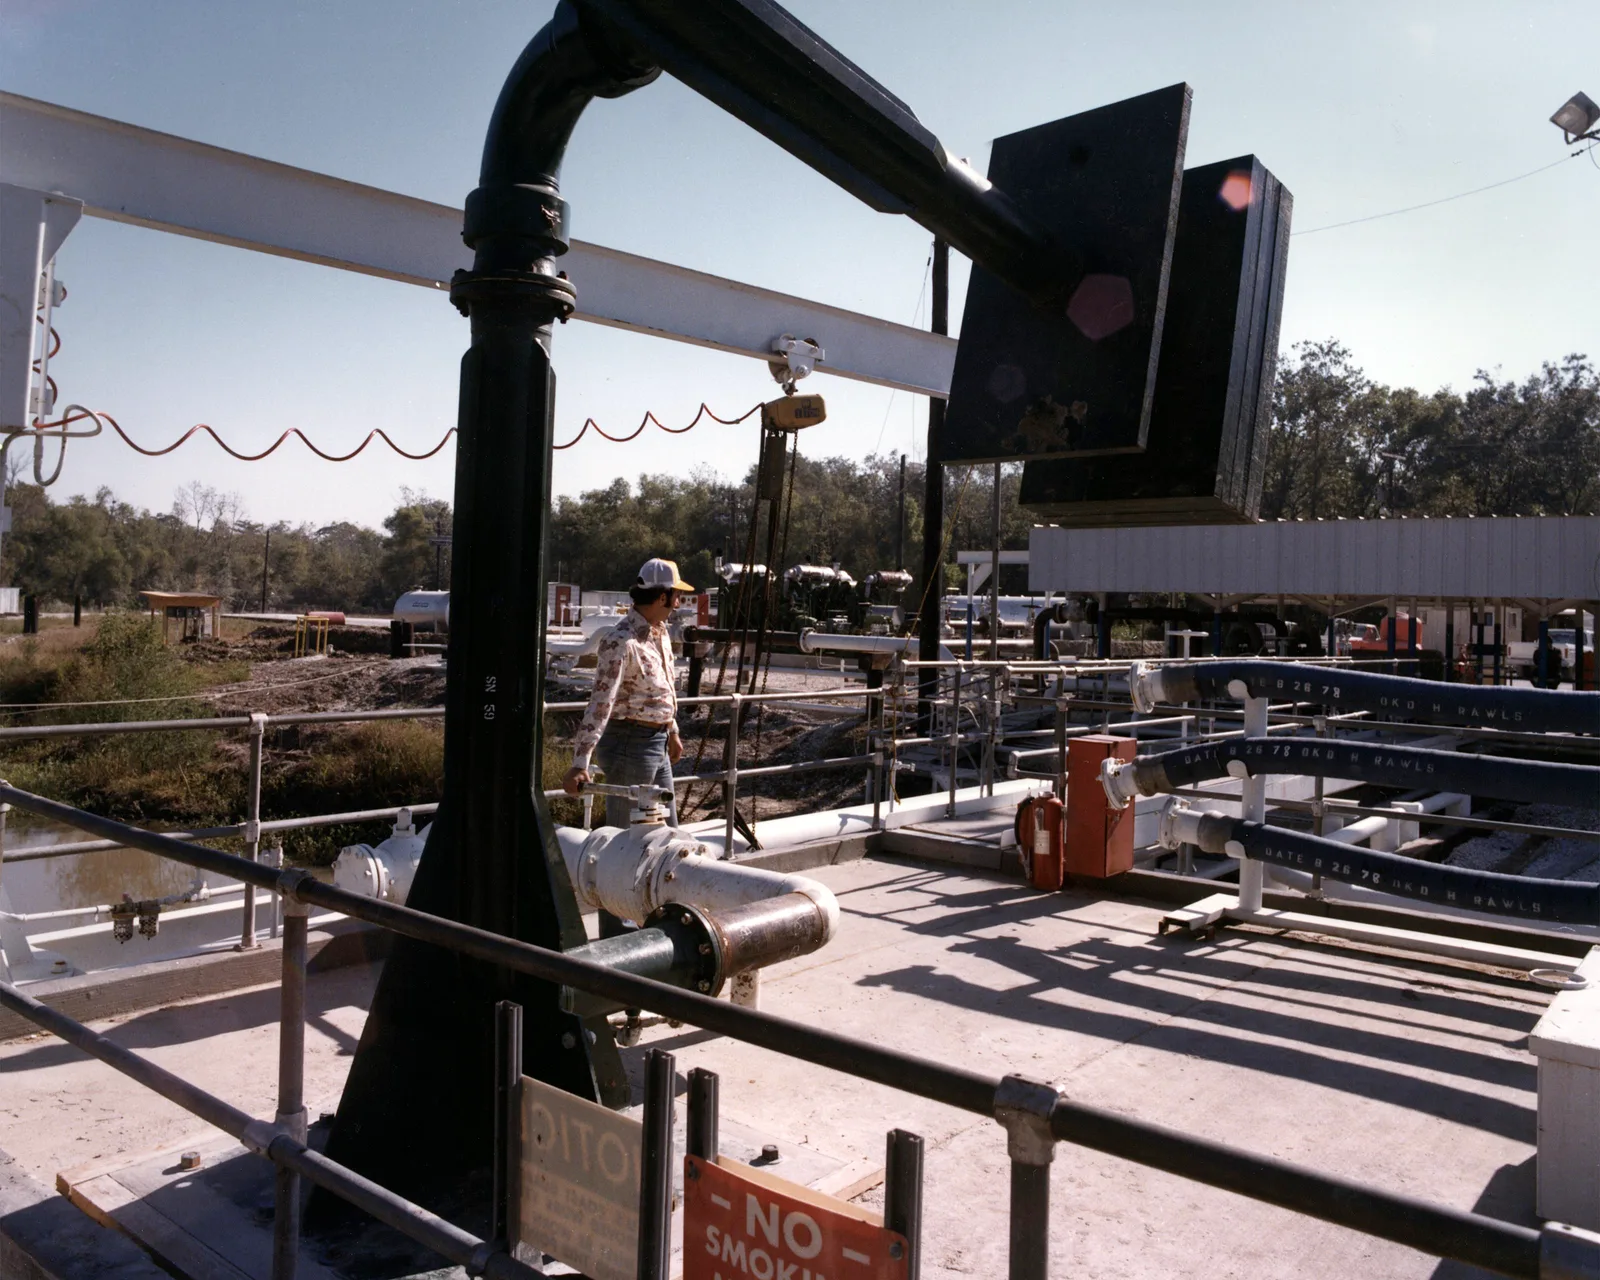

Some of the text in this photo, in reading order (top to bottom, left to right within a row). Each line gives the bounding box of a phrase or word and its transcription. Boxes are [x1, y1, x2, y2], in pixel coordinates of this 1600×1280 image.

[485, 676, 497, 692] SN
[1321, 685, 1341, 699] 78
[1432, 703, 1441, 713] H
[1458, 706, 1523, 722] RAWLS
[1272, 745, 1291, 757] 78
[1350, 752, 1359, 762] H
[1374, 756, 1434, 773] RAWLS
[1265, 847, 1304, 864] DATE
[1361, 870, 1381, 884] 78
[1447, 890, 1456, 901] H
[1473, 895, 1541, 913] RAWLS
[746, 1193, 823, 1260] NO
[705, 1224, 826, 1280] SMOK
